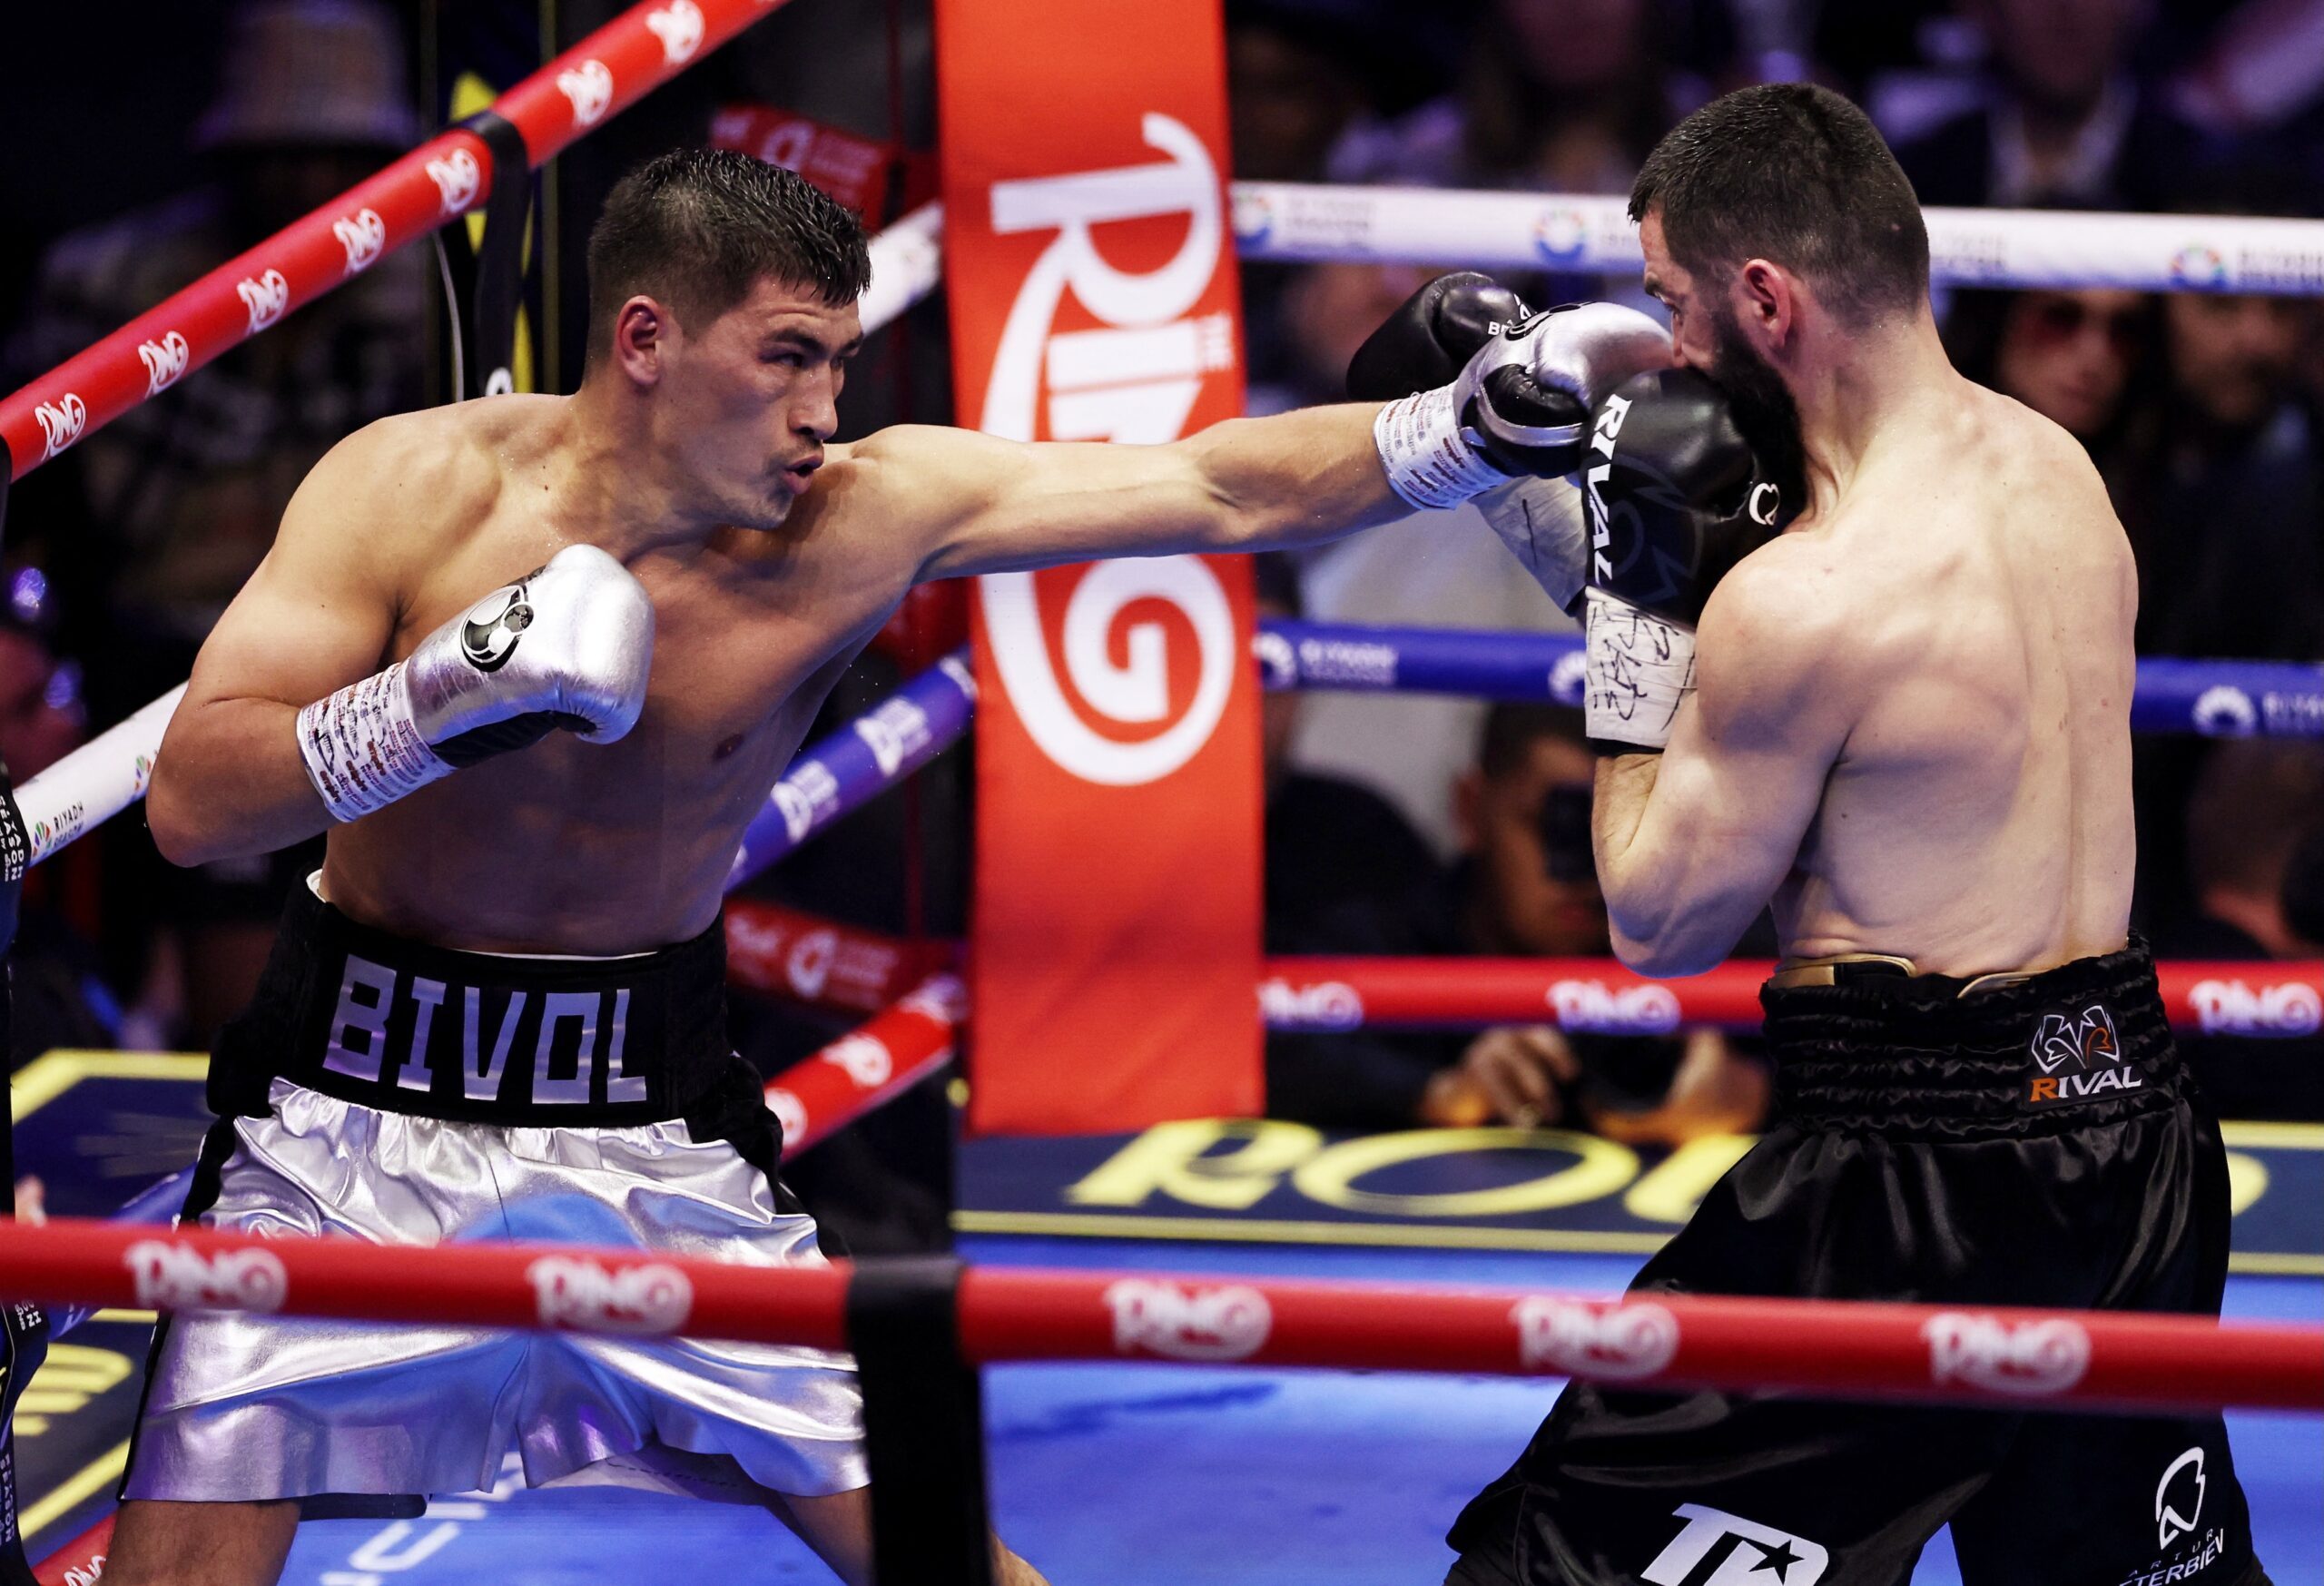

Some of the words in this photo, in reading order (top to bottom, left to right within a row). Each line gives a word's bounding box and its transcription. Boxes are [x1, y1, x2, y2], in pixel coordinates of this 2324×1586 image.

[34, 392, 86, 462] RING
[1587, 393, 1633, 586] RIVAL
[54, 802, 85, 831] RIYADH
[322, 953, 647, 1105] BIVOL
[2030, 1066, 2142, 1102] RIVAL
[2128, 1528, 2214, 1579] ARTUR
